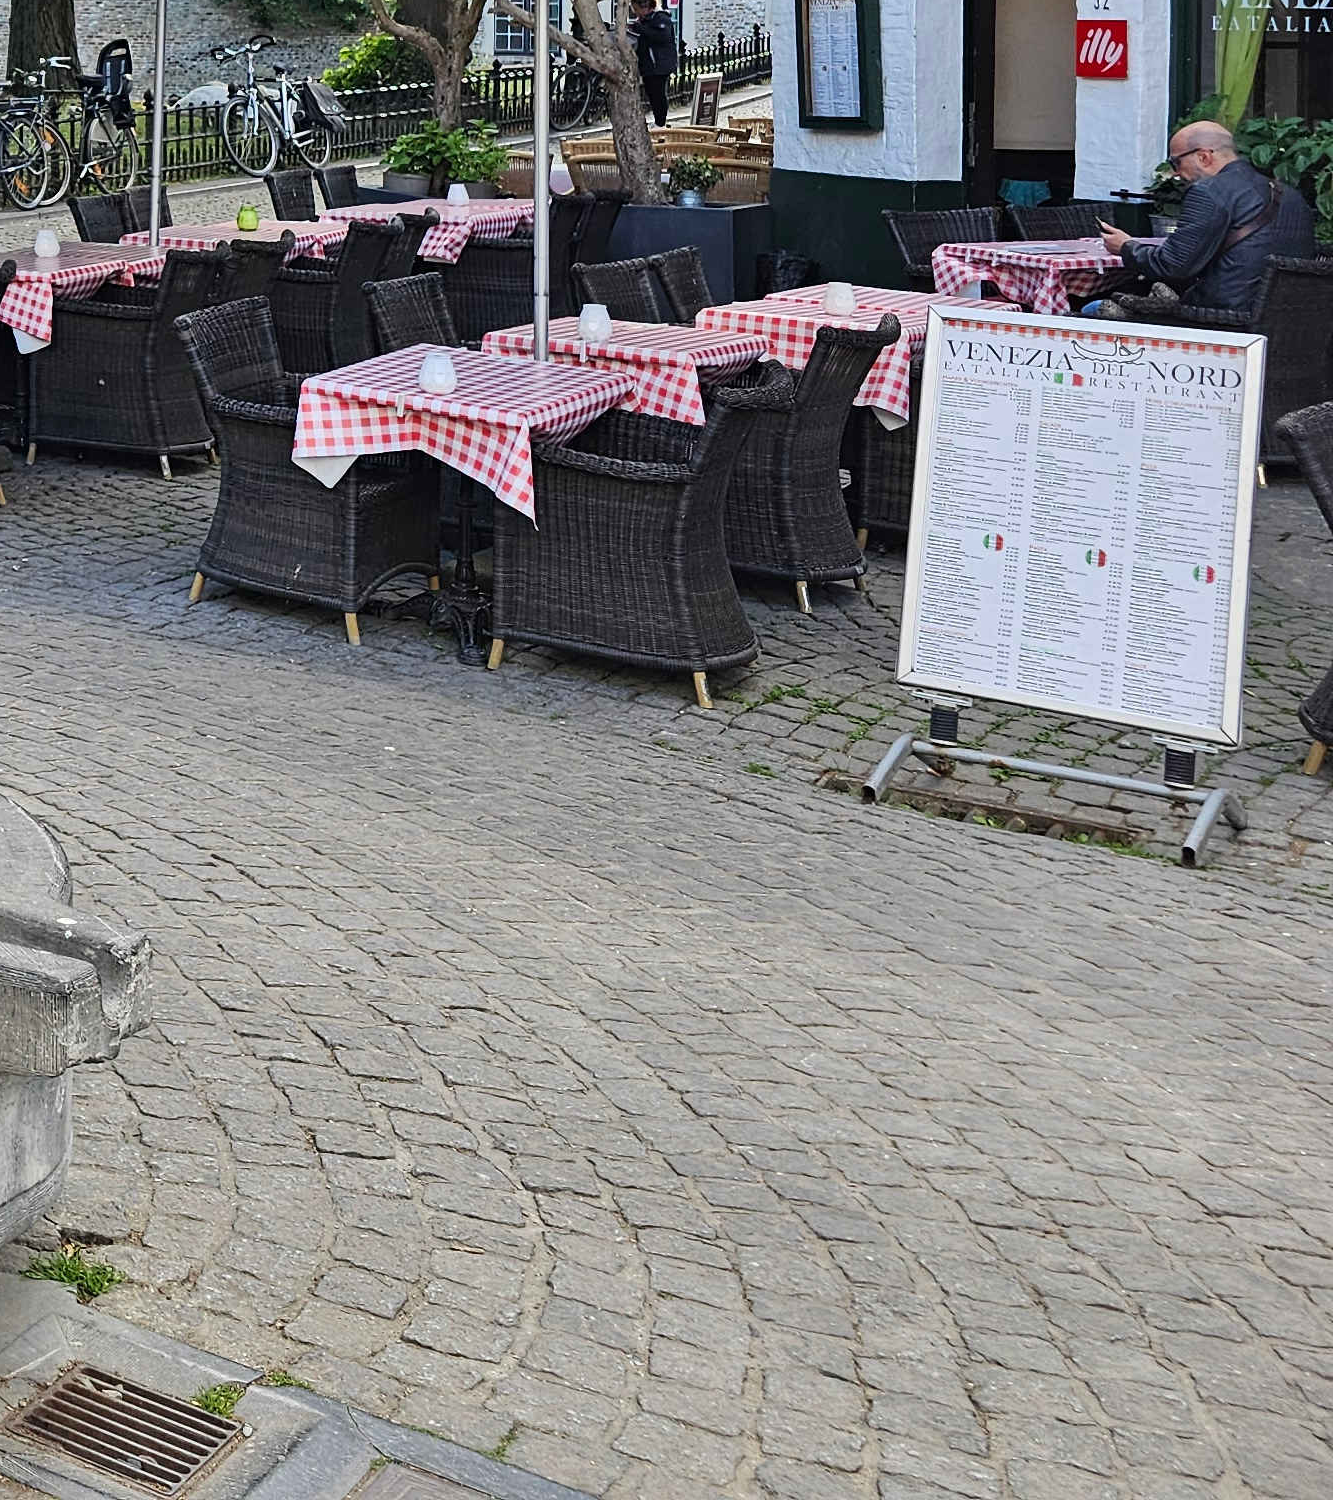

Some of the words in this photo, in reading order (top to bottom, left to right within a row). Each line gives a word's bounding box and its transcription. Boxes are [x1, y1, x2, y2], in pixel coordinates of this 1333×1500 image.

[1212, 15, 1333, 33] EATALIA
[1079, 27, 1124, 72] illy
[943, 361, 1053, 381] EATALIAN
[947, 339, 1074, 371] VENEZIA
[1093, 362, 1130, 377] DEL
[1147, 361, 1242, 389] NORD
[1089, 377, 1241, 403] RESTAURANT
